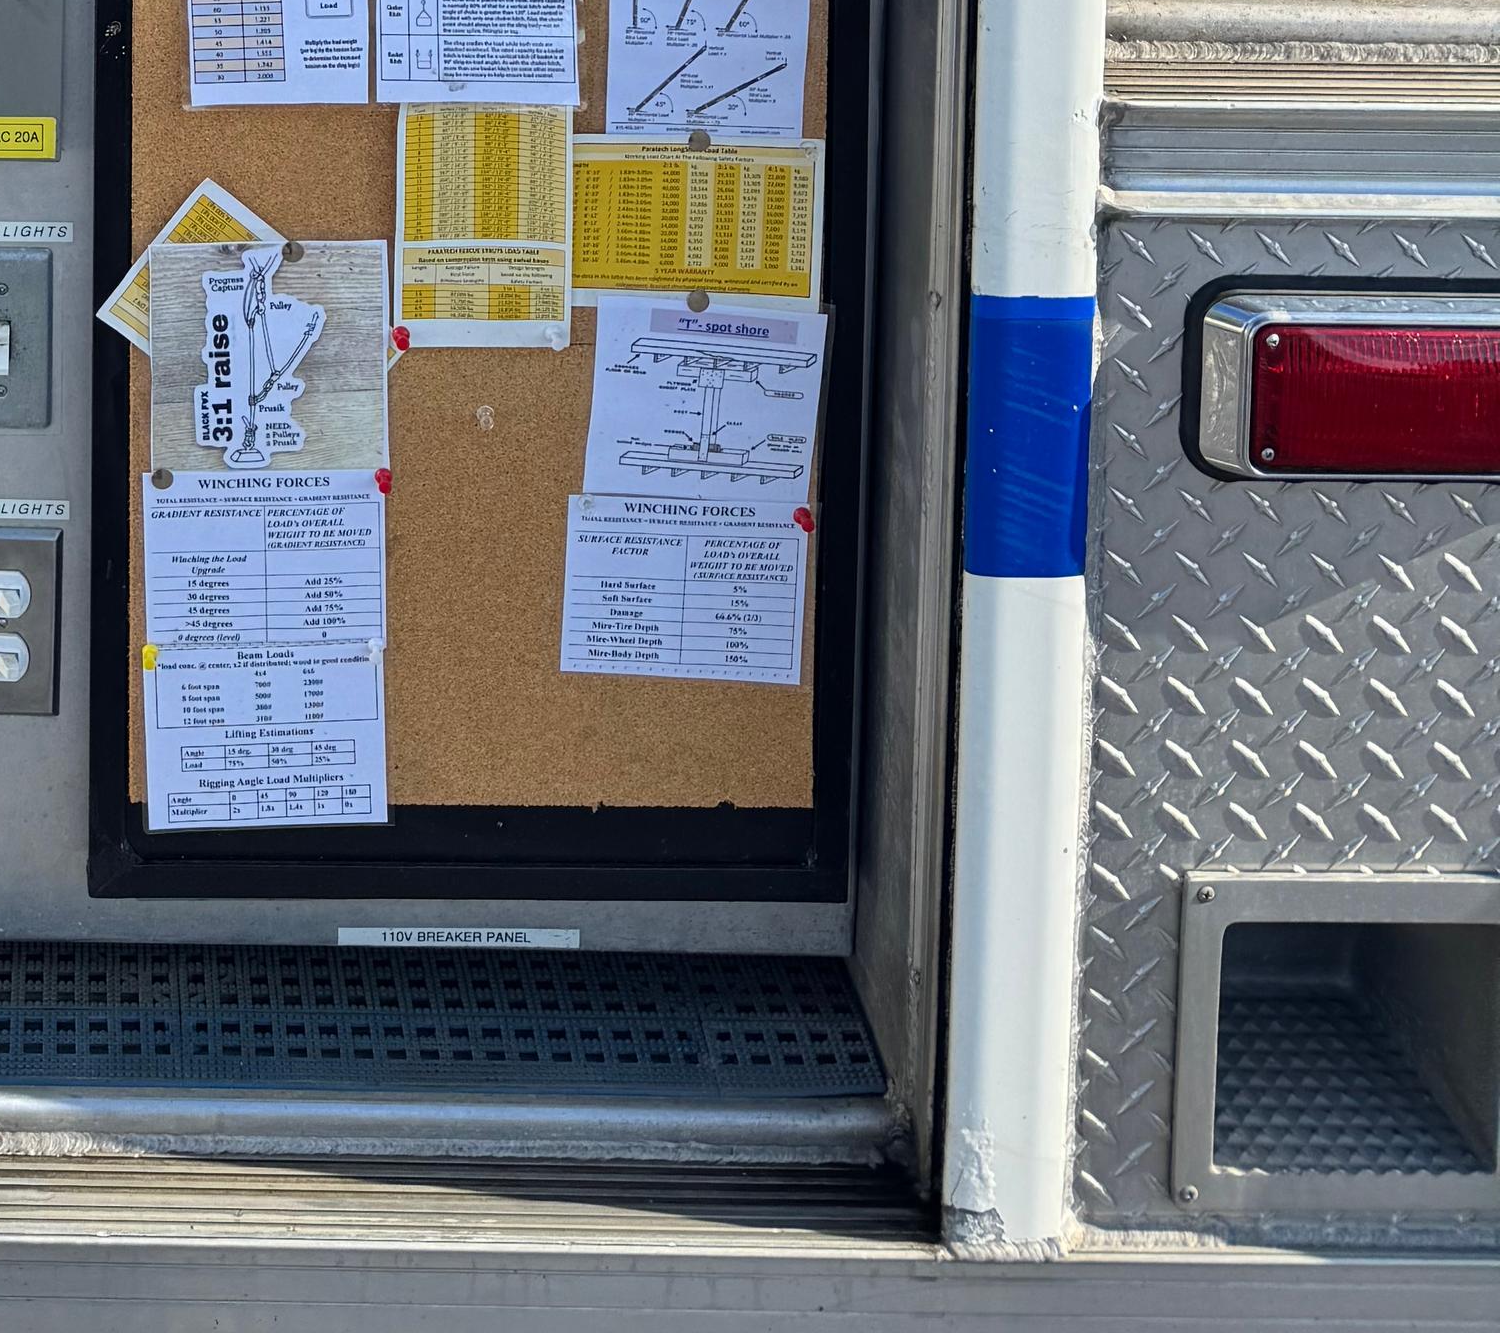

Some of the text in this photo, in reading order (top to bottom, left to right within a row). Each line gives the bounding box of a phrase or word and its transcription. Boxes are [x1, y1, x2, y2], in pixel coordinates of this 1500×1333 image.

[14, 130, 40, 144] 20A
[3, 225, 68, 238] LIGHTS
[209, 277, 244, 285] Progress
[270, 302, 292, 311] Pulley
[706, 322, 733, 333] spot
[735, 324, 770, 336] shore
[209, 314, 232, 442] 3:1 raise
[277, 383, 299, 392] Pulley
[259, 404, 285, 412] Prusik
[202, 411, 210, 440] BLACK
[272, 431, 300, 439] Pulleys
[198, 476, 330, 489] WINCHING FORCES
[1, 503, 66, 516] LIGHTS
[151, 509, 262, 519] GRADIENT RESISTANCE
[268, 507, 345, 517] PERCENTAGE OF
[624, 502, 756, 517] WINCHING FORCES
[301, 518, 344, 527] OVERALL
[268, 528, 372, 539] WEIGHT TO BE MOVED
[578, 535, 683, 547] SURFACE RESISTANCE
[704, 540, 766, 549] PERCENTAGE
[611, 547, 649, 556] FACTOR
[737, 552, 781, 560] OVERALL
[171, 555, 210, 564] Winching
[211, 555, 224, 563] the
[191, 566, 225, 574] Upgrade
[690, 561, 794, 572] WEIGHT MOVED
[199, 580, 229, 588] degrees
[305, 577, 343, 585] Add 25%
[600, 580, 656, 590] Hard Surface
[199, 593, 230, 602] degrees
[305, 591, 344, 599] Add 50%
[602, 594, 652, 604] Soft Surface
[199, 606, 230, 615] degrees
[305, 604, 322, 612] Add
[610, 608, 643, 618] Damage
[202, 620, 233, 628] degrees
[303, 617, 346, 626] Add 100%
[634, 623, 659, 633] Depth
[728, 627, 747, 635] 75%
[184, 634, 215, 642] degrees
[638, 637, 663, 647] Depth
[725, 640, 748, 649] 100%
[237, 650, 295, 660] Beam Loads
[635, 650, 660, 660] Depth
[225, 727, 314, 739] Lifting Estimations
[199, 774, 344, 789] Rigging Angle Load Multipliers
[381, 931, 531, 943] 110V BREAKER PANEL
